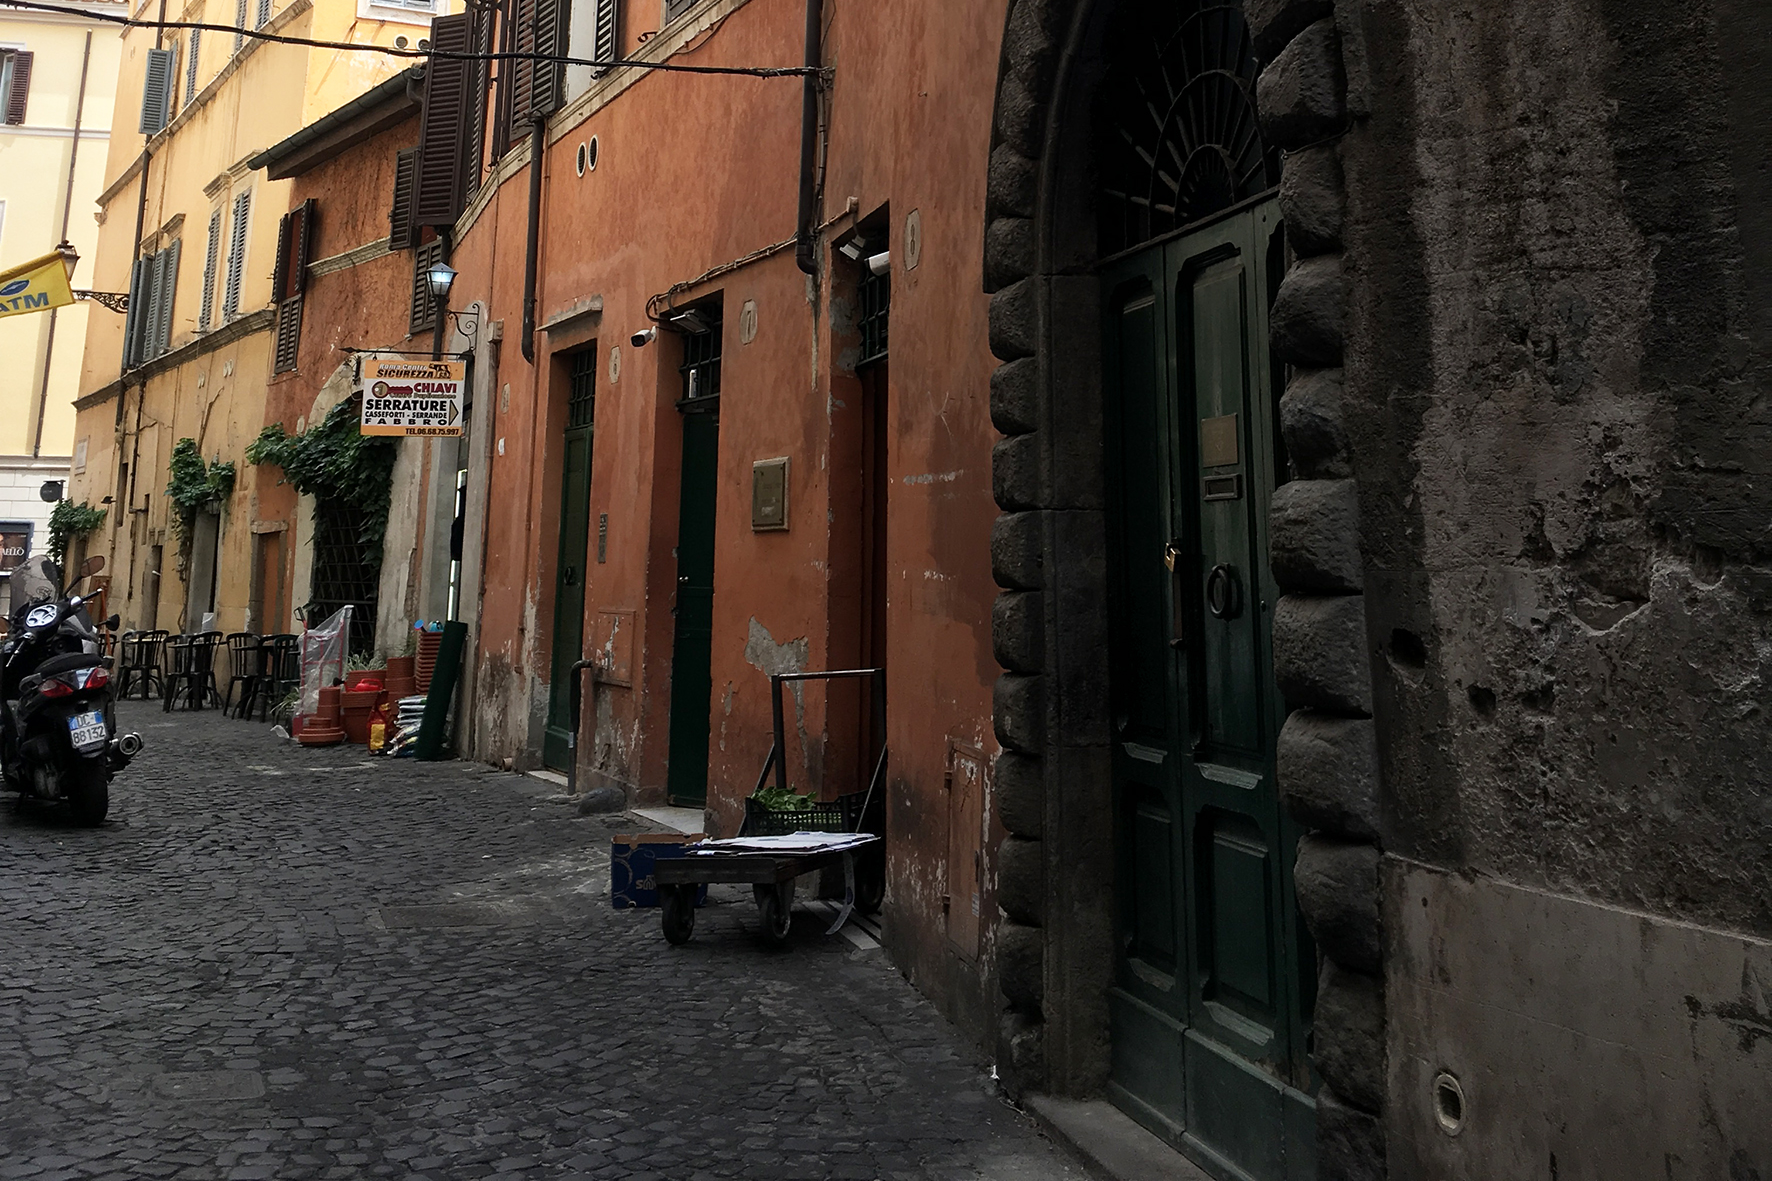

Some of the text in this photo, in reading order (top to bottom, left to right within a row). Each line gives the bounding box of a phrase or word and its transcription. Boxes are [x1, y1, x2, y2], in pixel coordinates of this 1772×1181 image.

[0, 292, 49, 312] ATM
[376, 369, 433, 378] SICUREZZA
[413, 383, 457, 393] CHIAVI
[365, 399, 447, 411] SERRATURE
[73, 725, 105, 744] 88132
